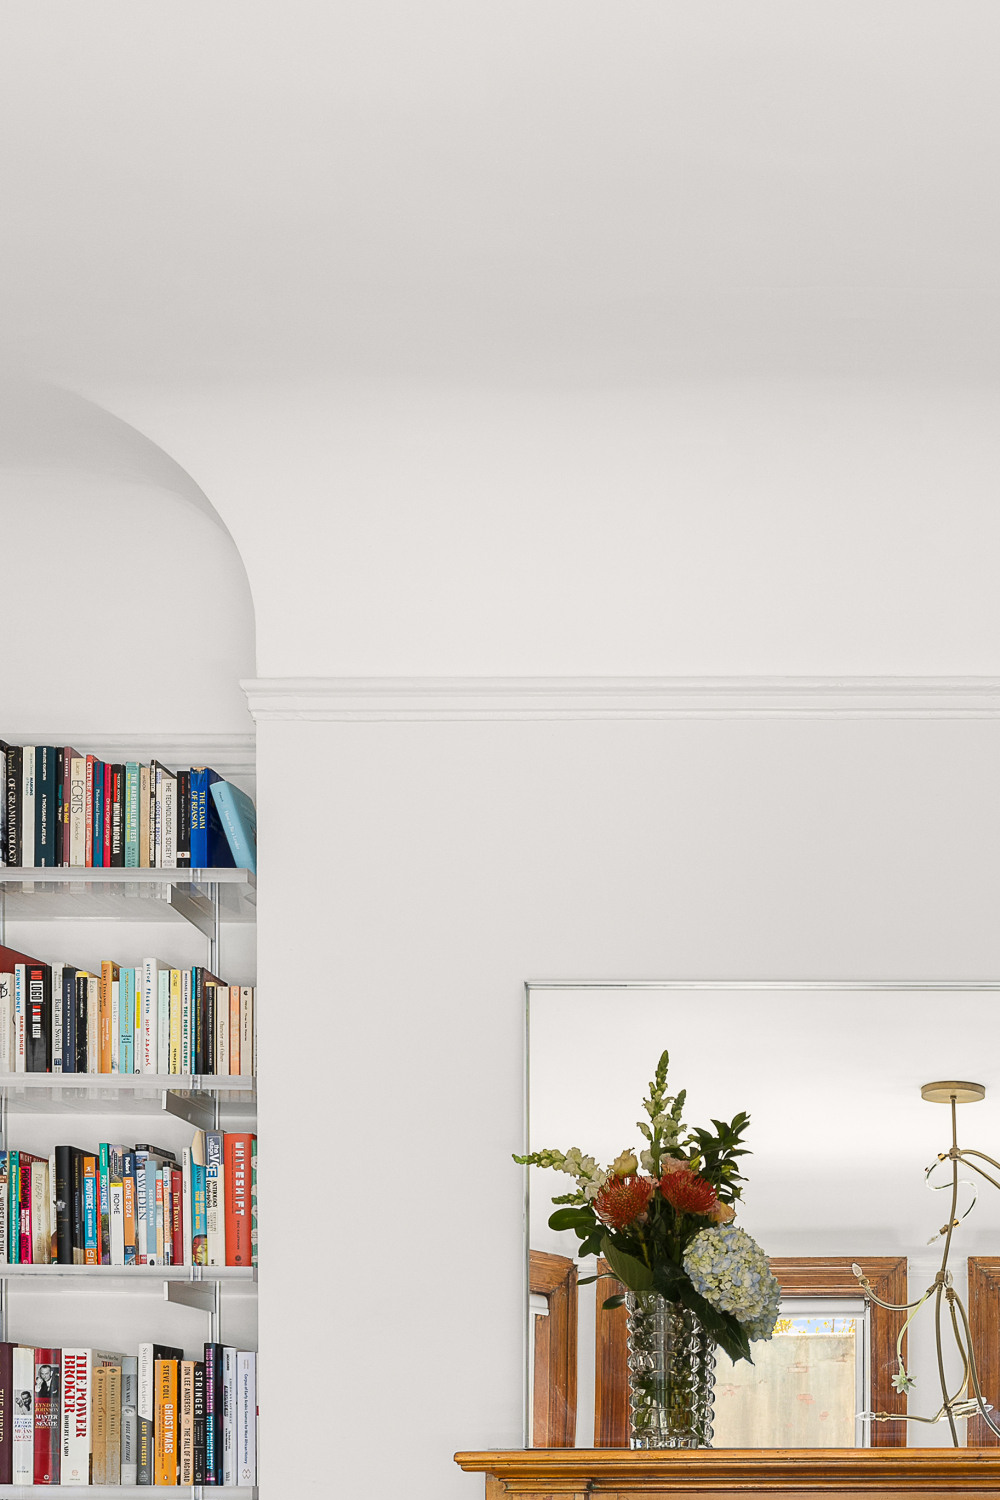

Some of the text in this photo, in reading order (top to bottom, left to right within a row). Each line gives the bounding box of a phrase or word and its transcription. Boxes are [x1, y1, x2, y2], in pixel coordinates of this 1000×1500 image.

[9, 778, 15, 789] OF
[192, 791, 198, 800] OF
[31, 971, 42, 1000] NO LOGO
[21, 1168, 30, 1209] PROPAGANDA
[138, 1173, 146, 1220] SWEDEN
[235, 1142, 244, 1216] WHITESHIFT
[65, 1355, 75, 1413] BROKER
[76, 1352, 87, 1438] THE POWER
[165, 1404, 173, 1430] GHOST
